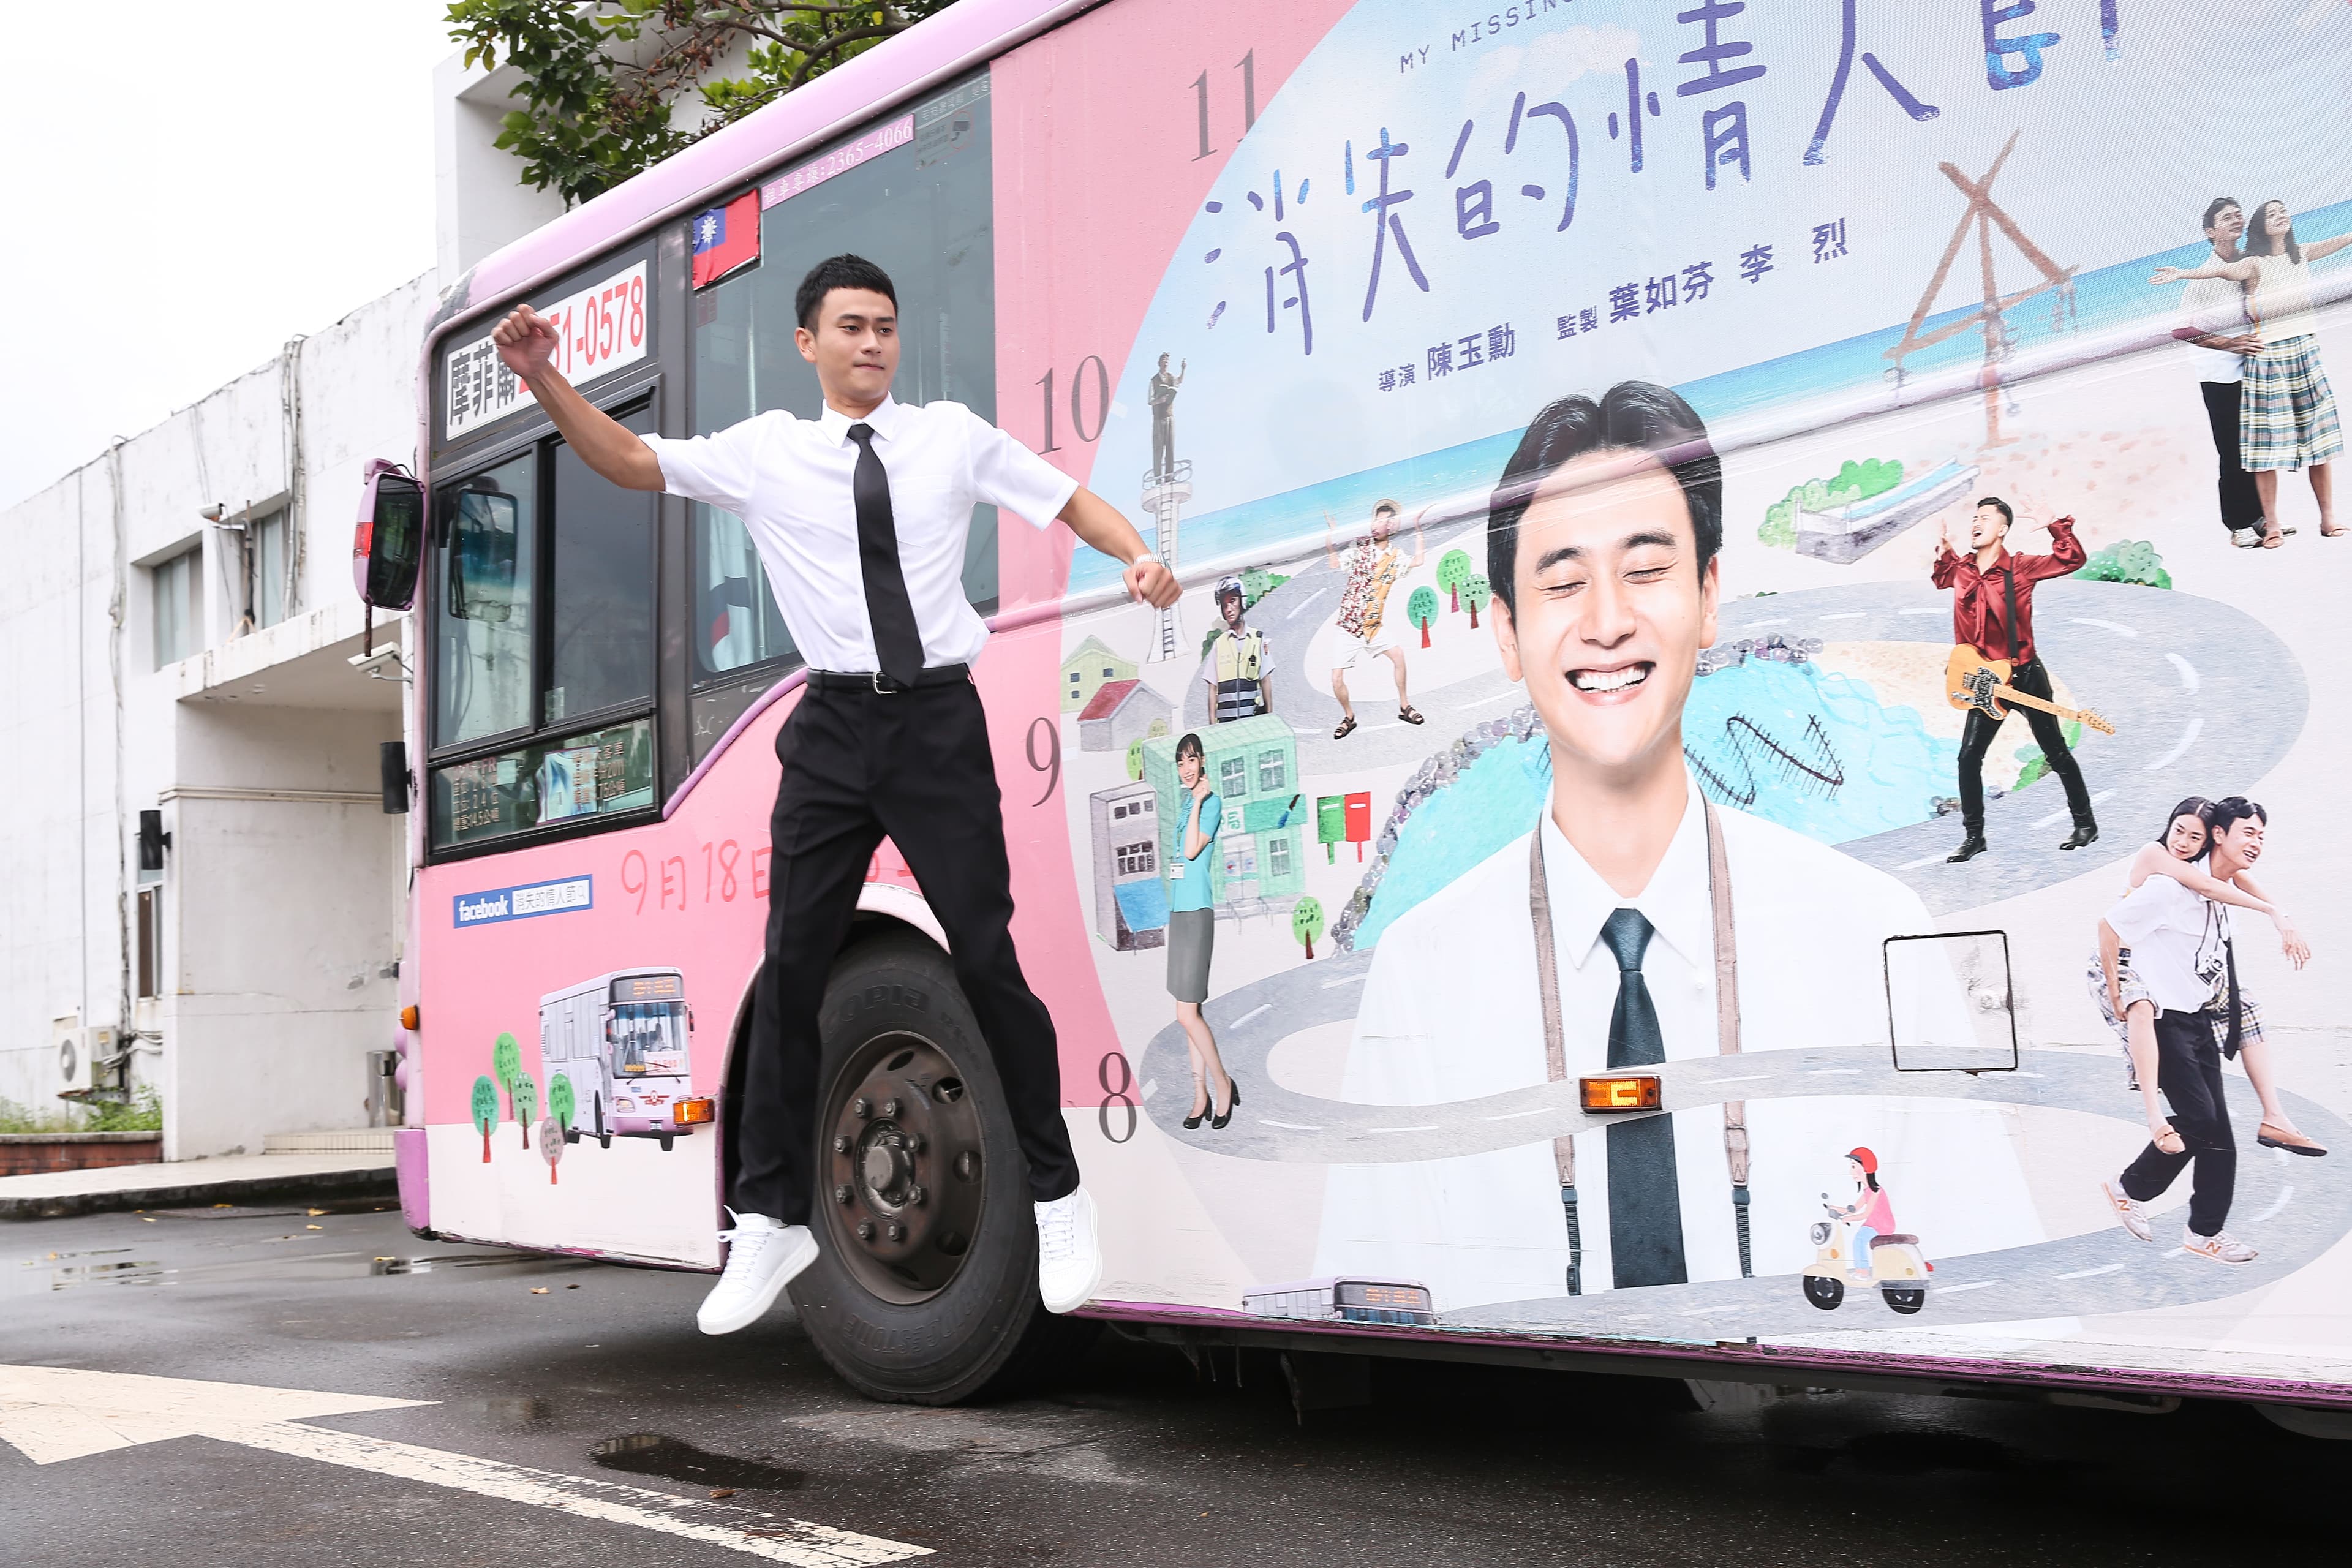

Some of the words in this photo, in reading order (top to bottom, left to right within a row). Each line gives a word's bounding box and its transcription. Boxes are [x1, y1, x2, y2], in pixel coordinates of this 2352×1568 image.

[1400, 44, 1430, 74] MY
[1452, 0, 1573, 51] MISSIN
[1188, 47, 1255, 162] 11
[1379, 363, 1415, 392] 導演
[1427, 322, 1515, 381] 陳玉勳
[1557, 305, 1598, 341] 監製
[1608, 260, 1714, 323] 葉如芬
[1035, 355, 1109, 456] 10
[1026, 717, 1062, 807] 9
[458, 894, 509, 922] facebook
[1098, 1052, 1137, 1144] 8
